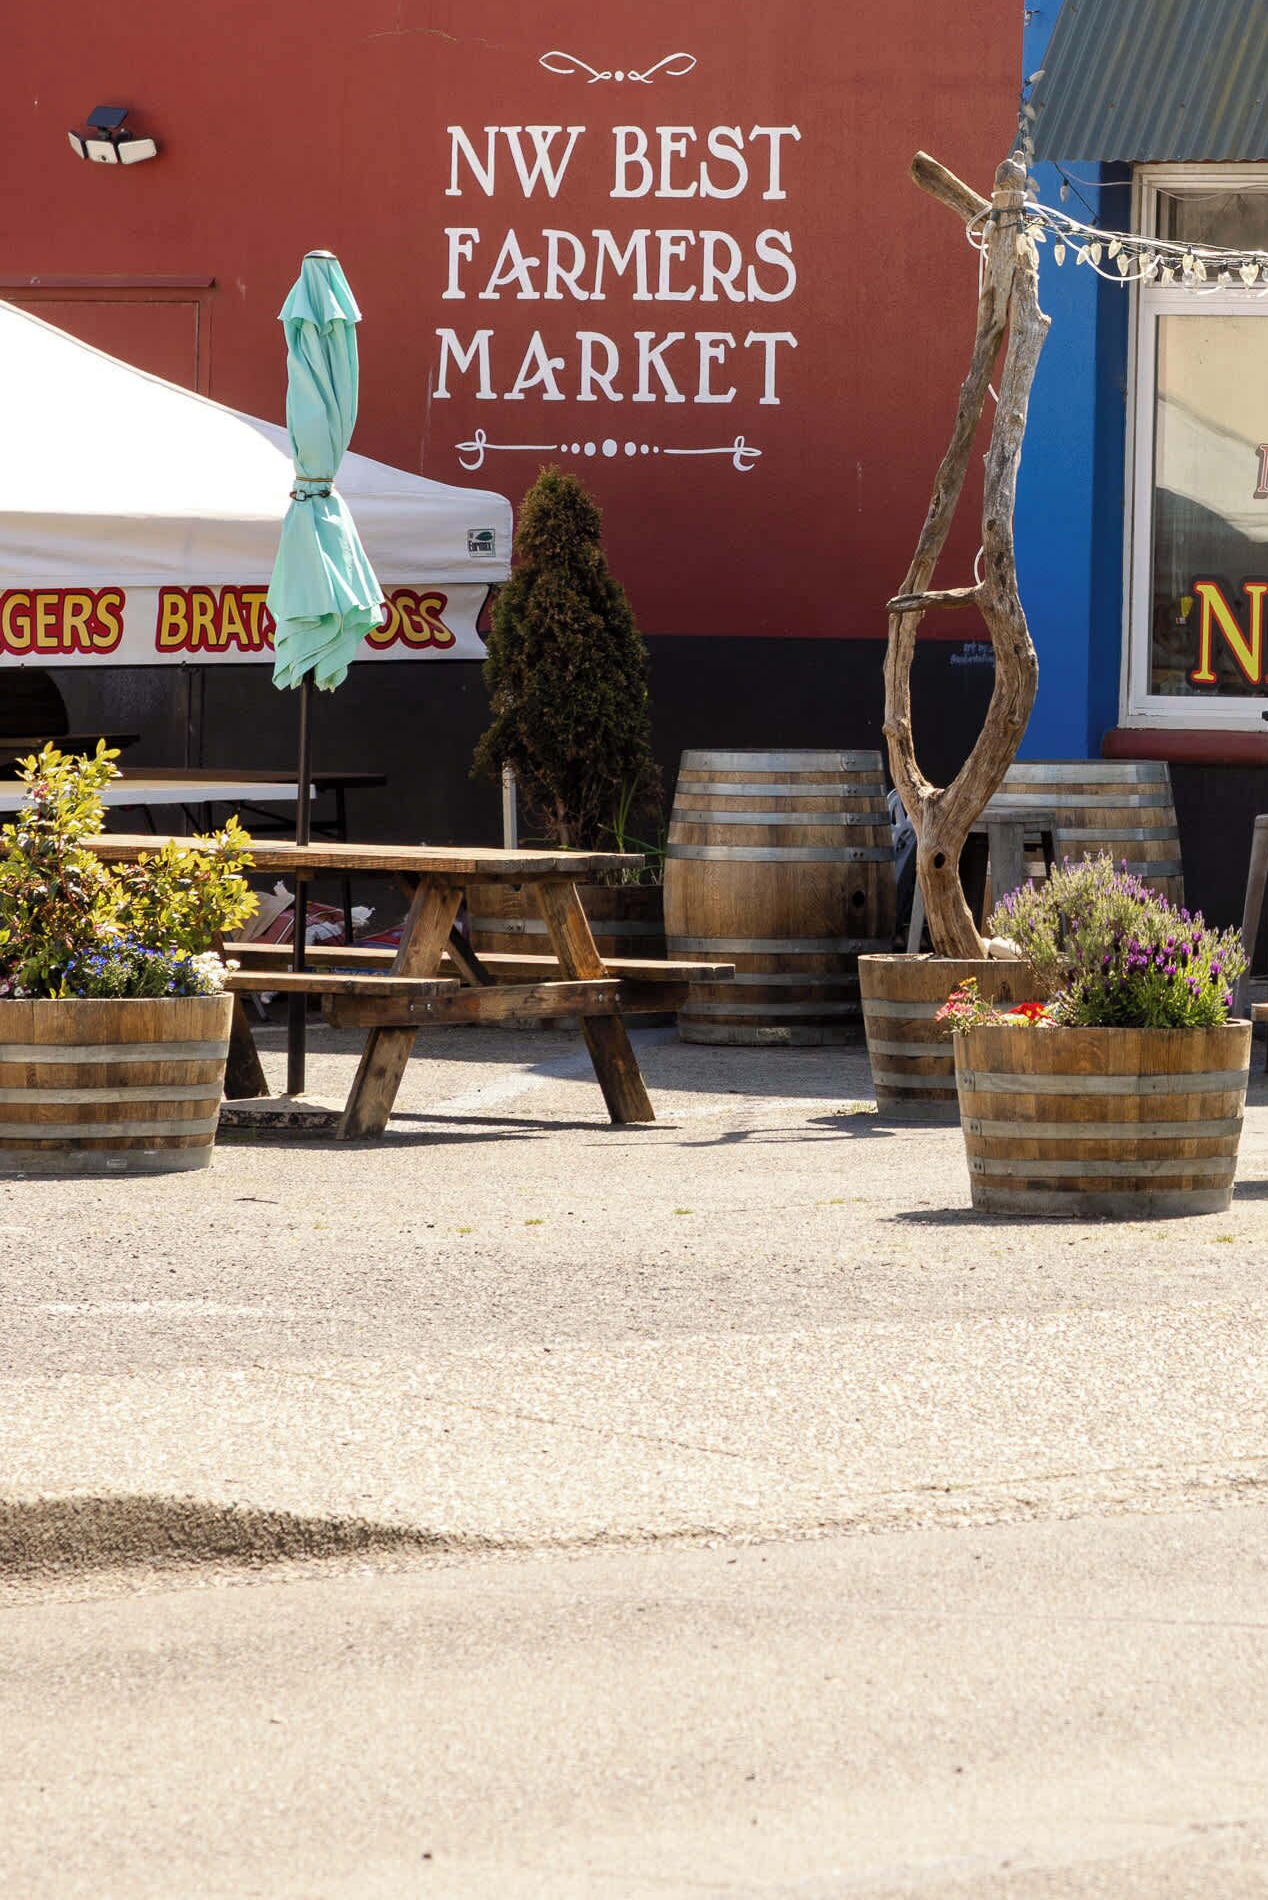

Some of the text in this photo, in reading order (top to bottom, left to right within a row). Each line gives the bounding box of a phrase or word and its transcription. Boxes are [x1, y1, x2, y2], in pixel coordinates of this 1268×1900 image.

[445, 124, 802, 201] NW BEST
[441, 227, 797, 303] FARMERS
[432, 328, 798, 405] MARKET
[159, 592, 276, 648] BRAT
